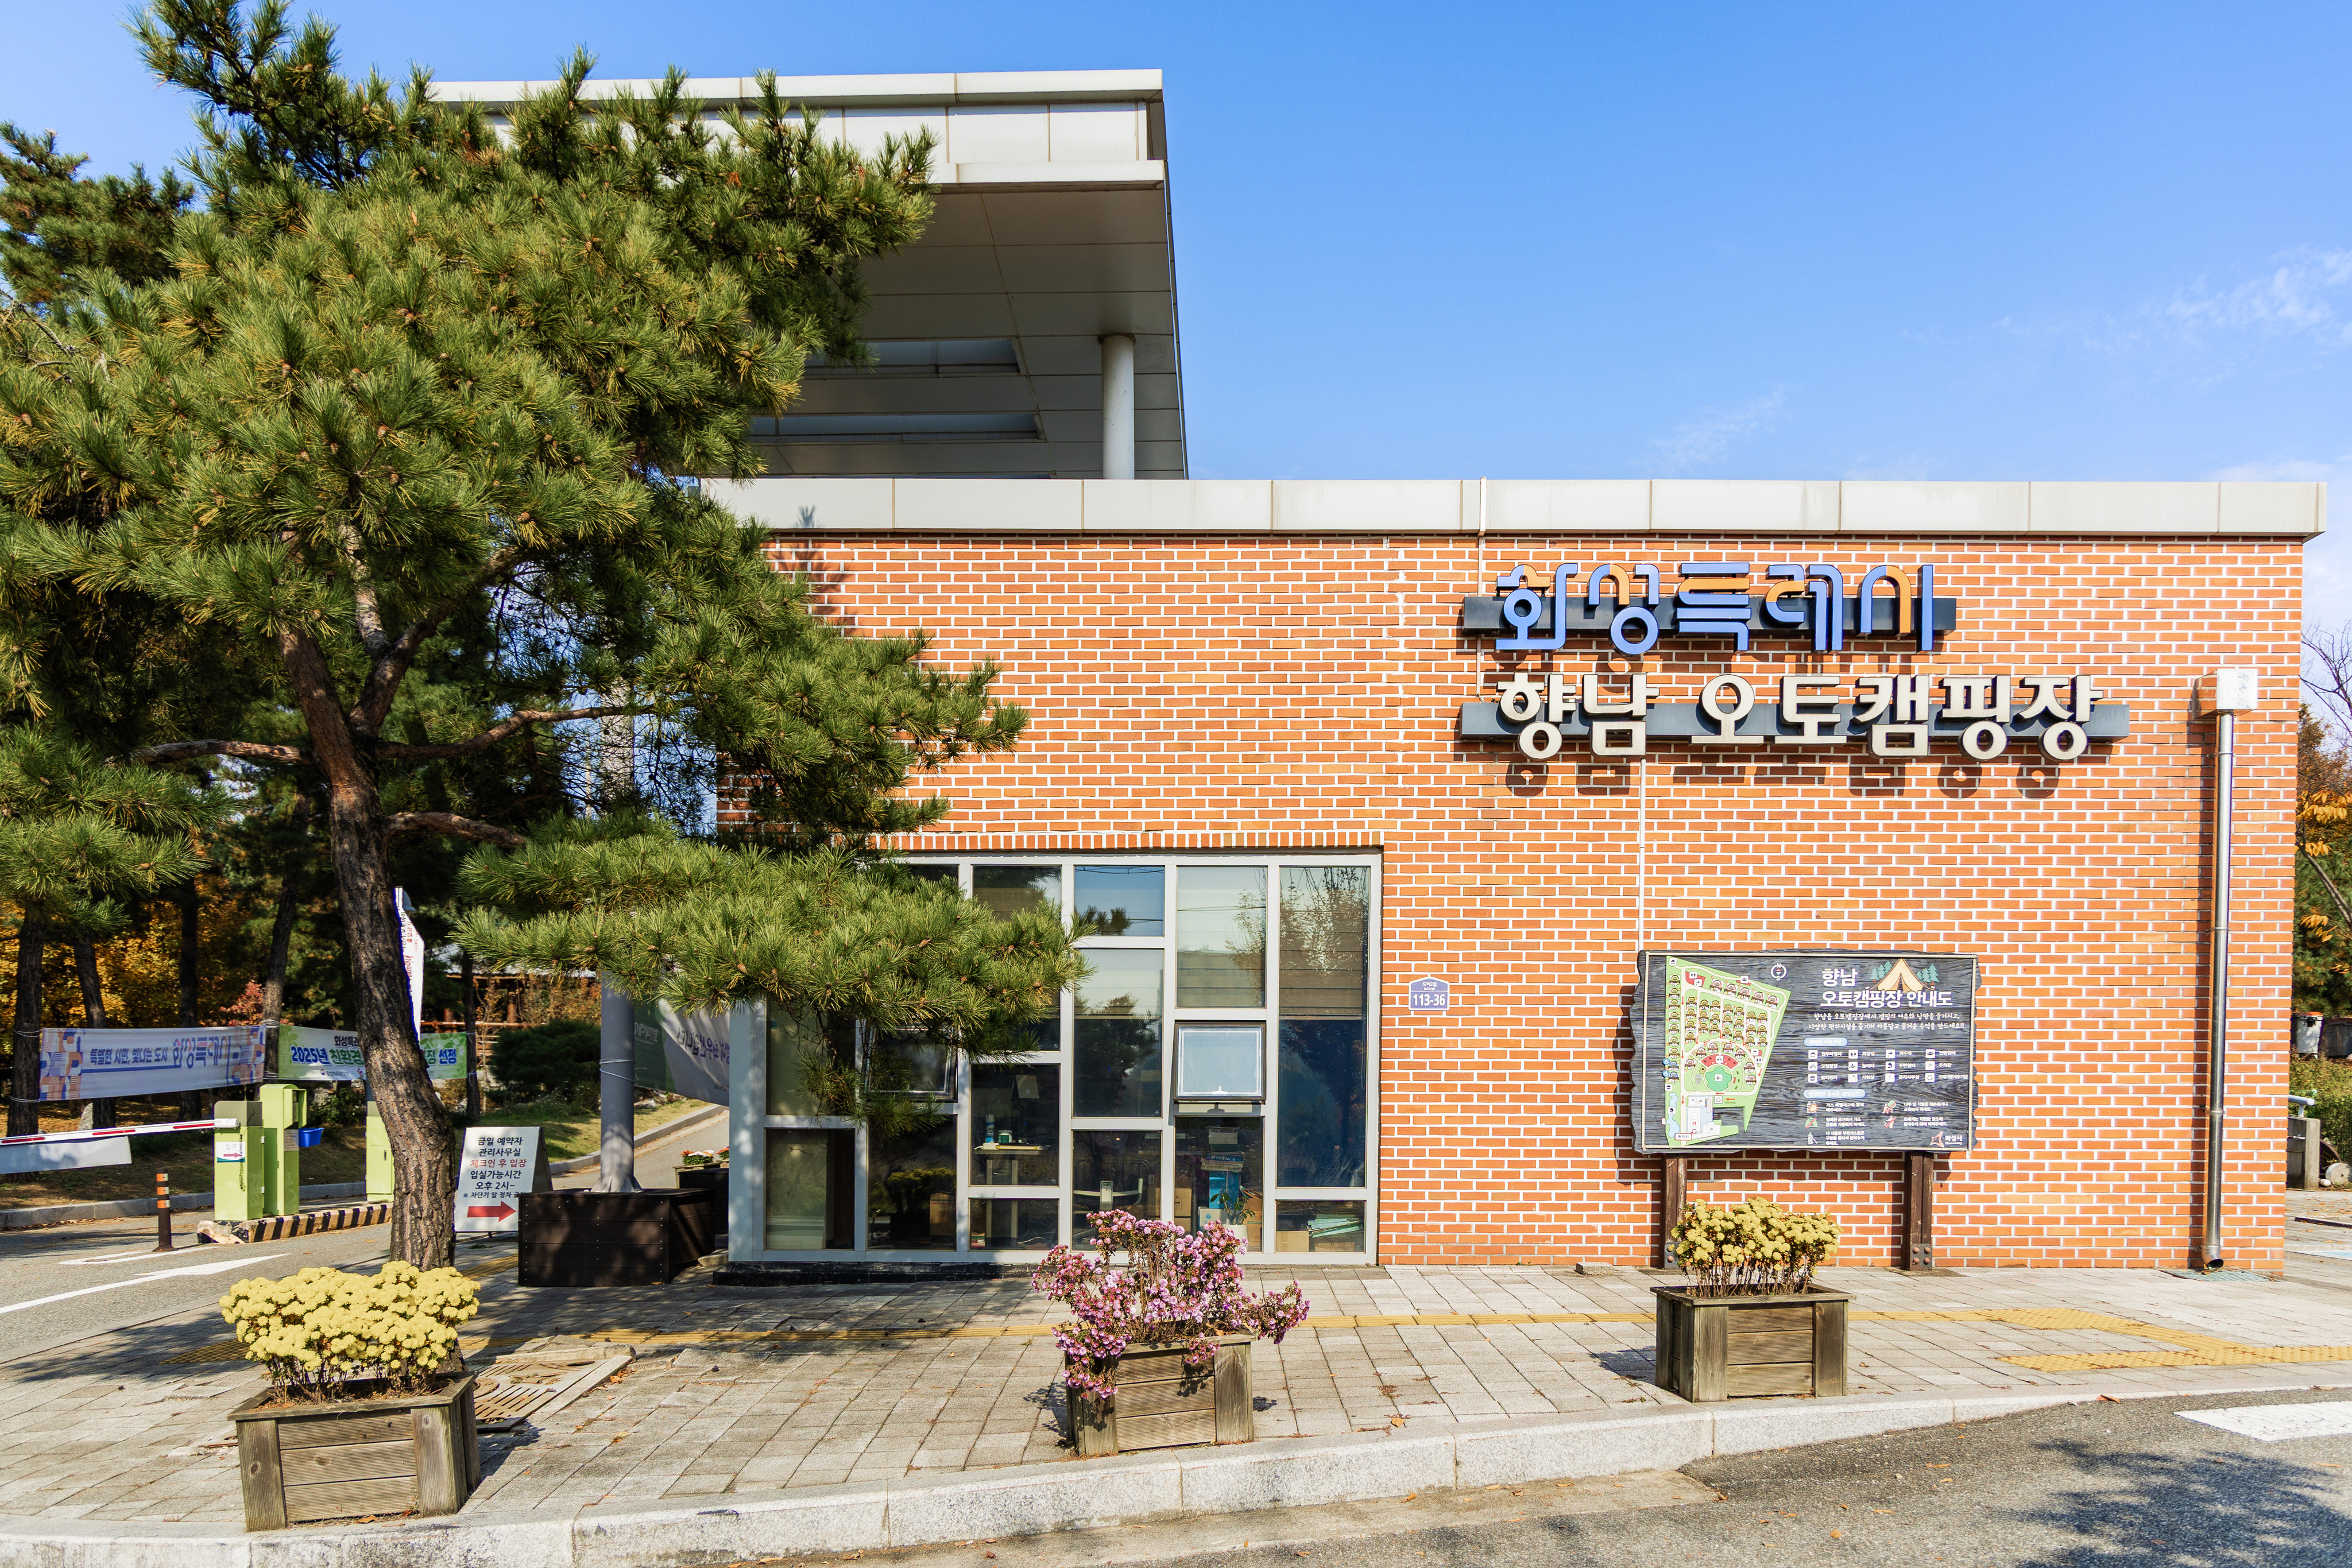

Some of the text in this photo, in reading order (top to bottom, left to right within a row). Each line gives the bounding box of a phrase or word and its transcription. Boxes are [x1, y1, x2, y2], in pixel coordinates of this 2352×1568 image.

[1495, 562, 1934, 655] 화성특례시
[1496, 672, 2103, 760] 향남 오토캠핑장
[1821, 968, 1858, 986] 향남
[1413, 994, 1445, 1006] 113-36
[1820, 990, 1953, 1008] 오토캠핑장 안내도
[90, 1048, 112, 1065] 특별한
[114, 1048, 129, 1064] 시민,
[132, 1048, 152, 1063] 빛나는
[154, 1047, 168, 1062] 도시
[291, 1045, 330, 1064] 2025년
[329, 1048, 364, 1064] 친환경
[438, 1048, 457, 1064] 선정
[478, 1137, 523, 1146] 금일 예약자
[478, 1148, 520, 1156] 관리사무실
[470, 1159, 527, 1168] 체크인 후 입장
[471, 1170, 521, 1179] 입실가능시간
[475, 1181, 515, 1190] 오후 2시~
